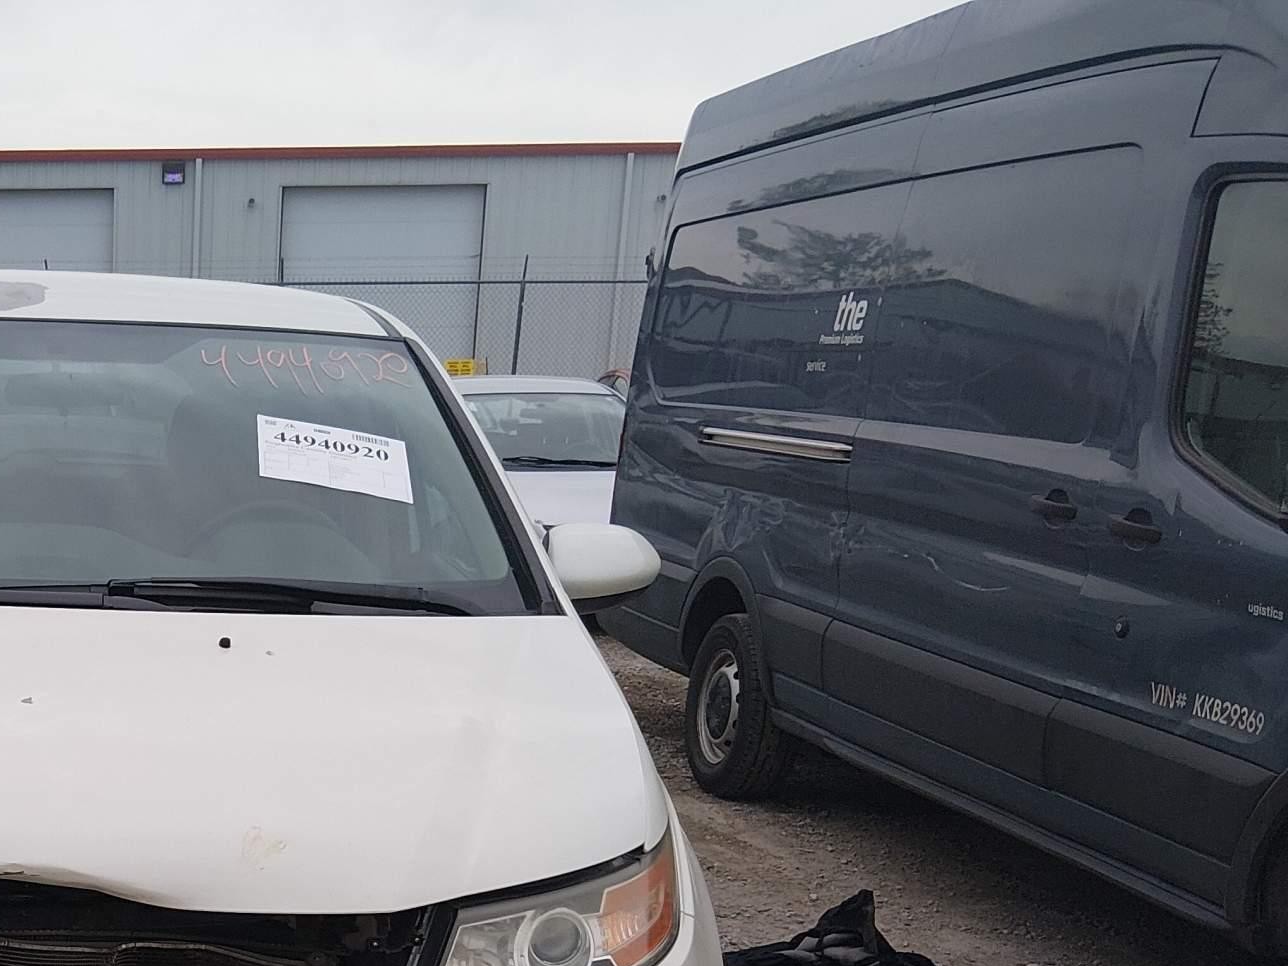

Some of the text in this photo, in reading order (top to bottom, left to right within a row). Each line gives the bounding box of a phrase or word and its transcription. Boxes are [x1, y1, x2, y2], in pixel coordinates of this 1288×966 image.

[833, 291, 868, 332] the
[273, 431, 389, 461] 44940920
[1151, 681, 1265, 735] VIN# KKB29369
